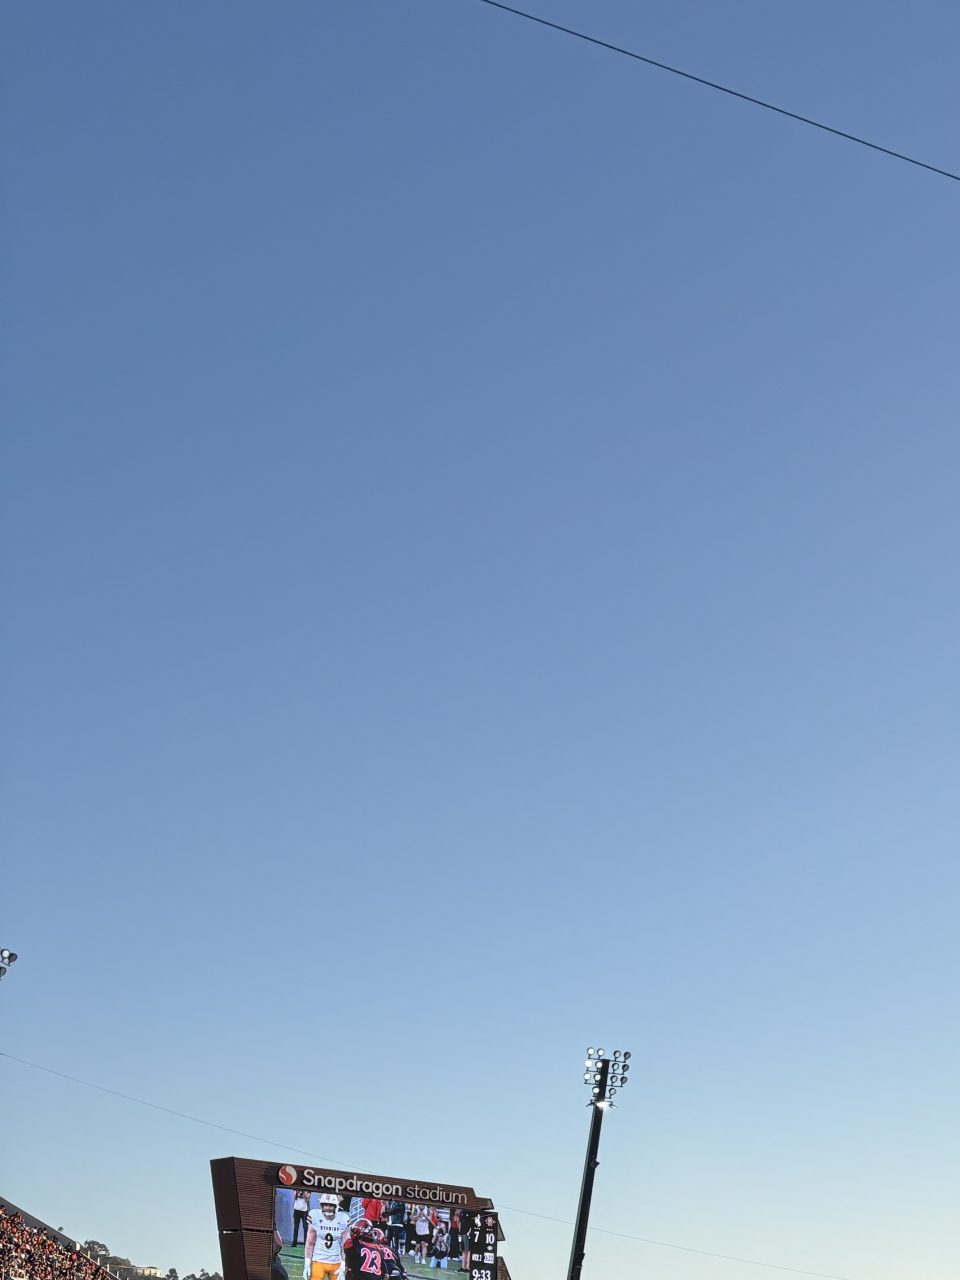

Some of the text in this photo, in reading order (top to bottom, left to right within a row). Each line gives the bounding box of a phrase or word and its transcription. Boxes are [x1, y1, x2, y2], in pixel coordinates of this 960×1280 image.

[302, 1168, 467, 1204] Snapdragon stadium
[324, 1232, 334, 1248] 9
[474, 1231, 495, 1244] 7 10
[360, 1247, 382, 1275] 23
